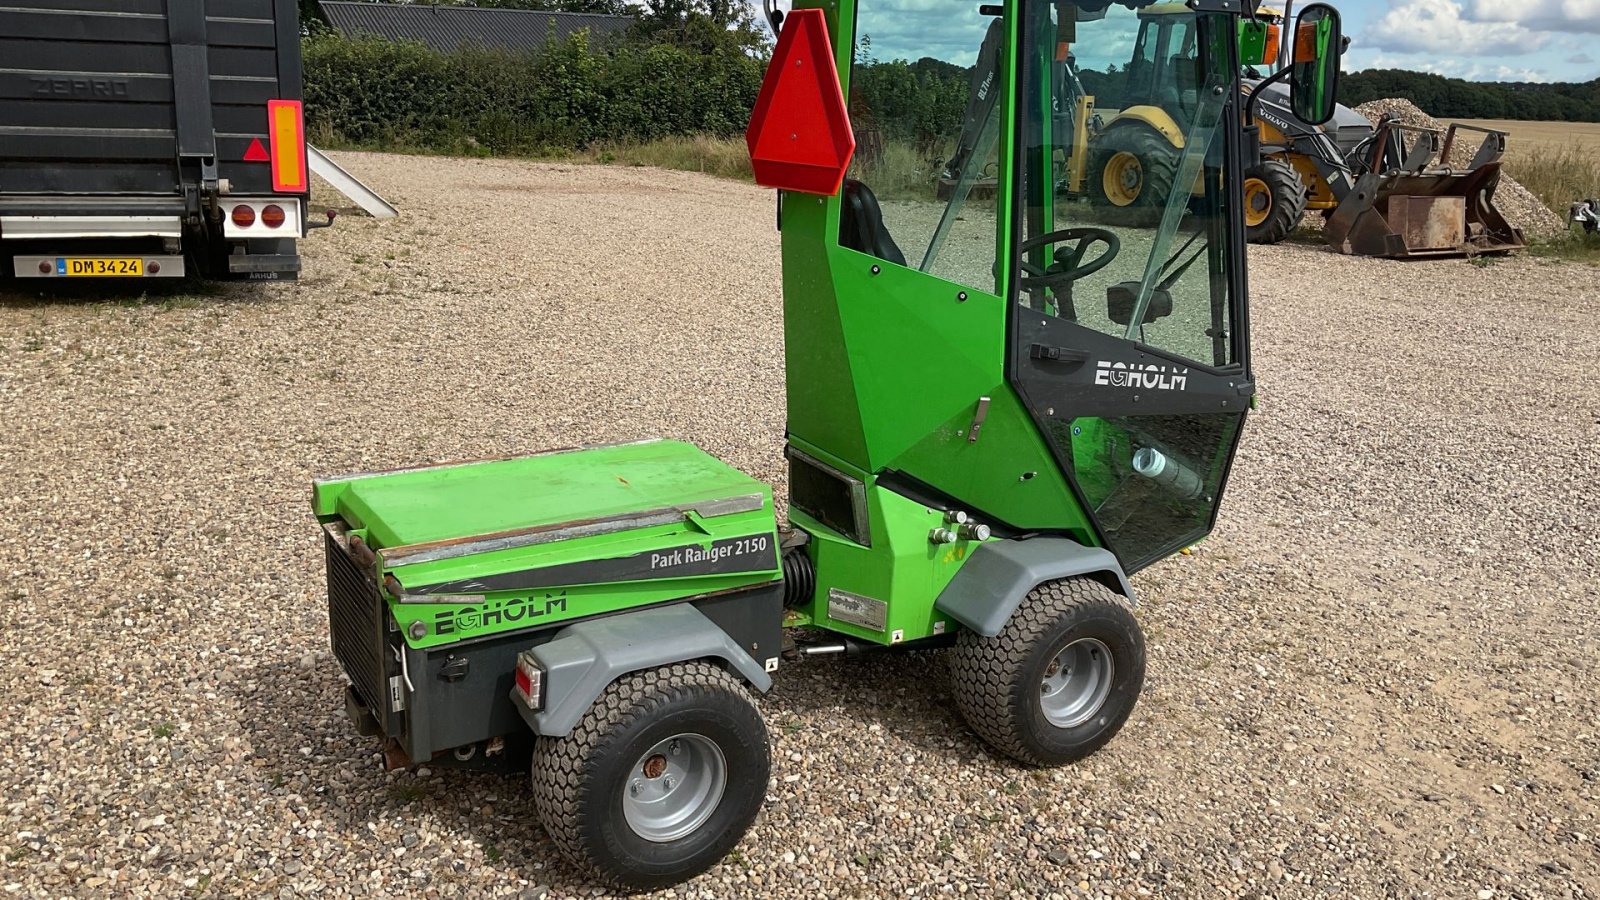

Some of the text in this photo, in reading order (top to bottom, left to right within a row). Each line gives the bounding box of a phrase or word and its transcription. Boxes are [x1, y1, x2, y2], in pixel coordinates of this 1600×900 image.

[29, 77, 128, 97] ZEPRO
[1260, 108, 1289, 129] VOLVO
[72, 260, 138, 273] DM 34 24
[1094, 360, 1188, 391] EGHOLM
[651, 537, 767, 569] Park Ranger 2150
[434, 590, 567, 635] EGHOLM
